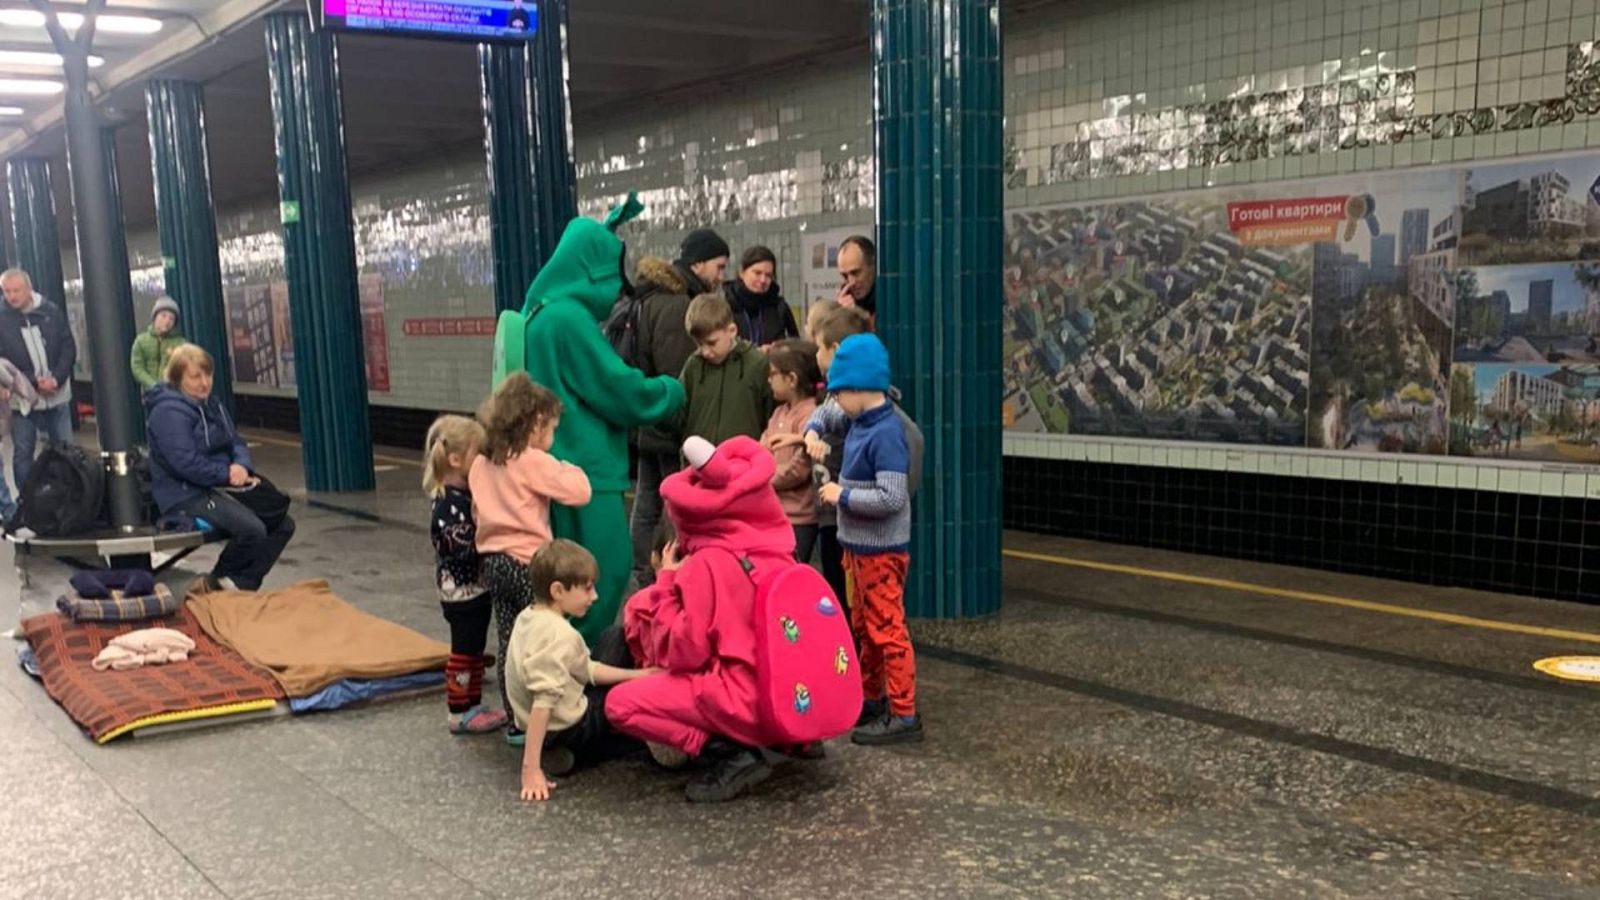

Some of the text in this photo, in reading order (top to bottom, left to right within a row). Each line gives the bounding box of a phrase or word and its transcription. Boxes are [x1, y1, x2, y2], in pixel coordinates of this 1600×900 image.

[1231, 202, 1341, 221] Готові квартири
[1254, 226, 1331, 240] документами
